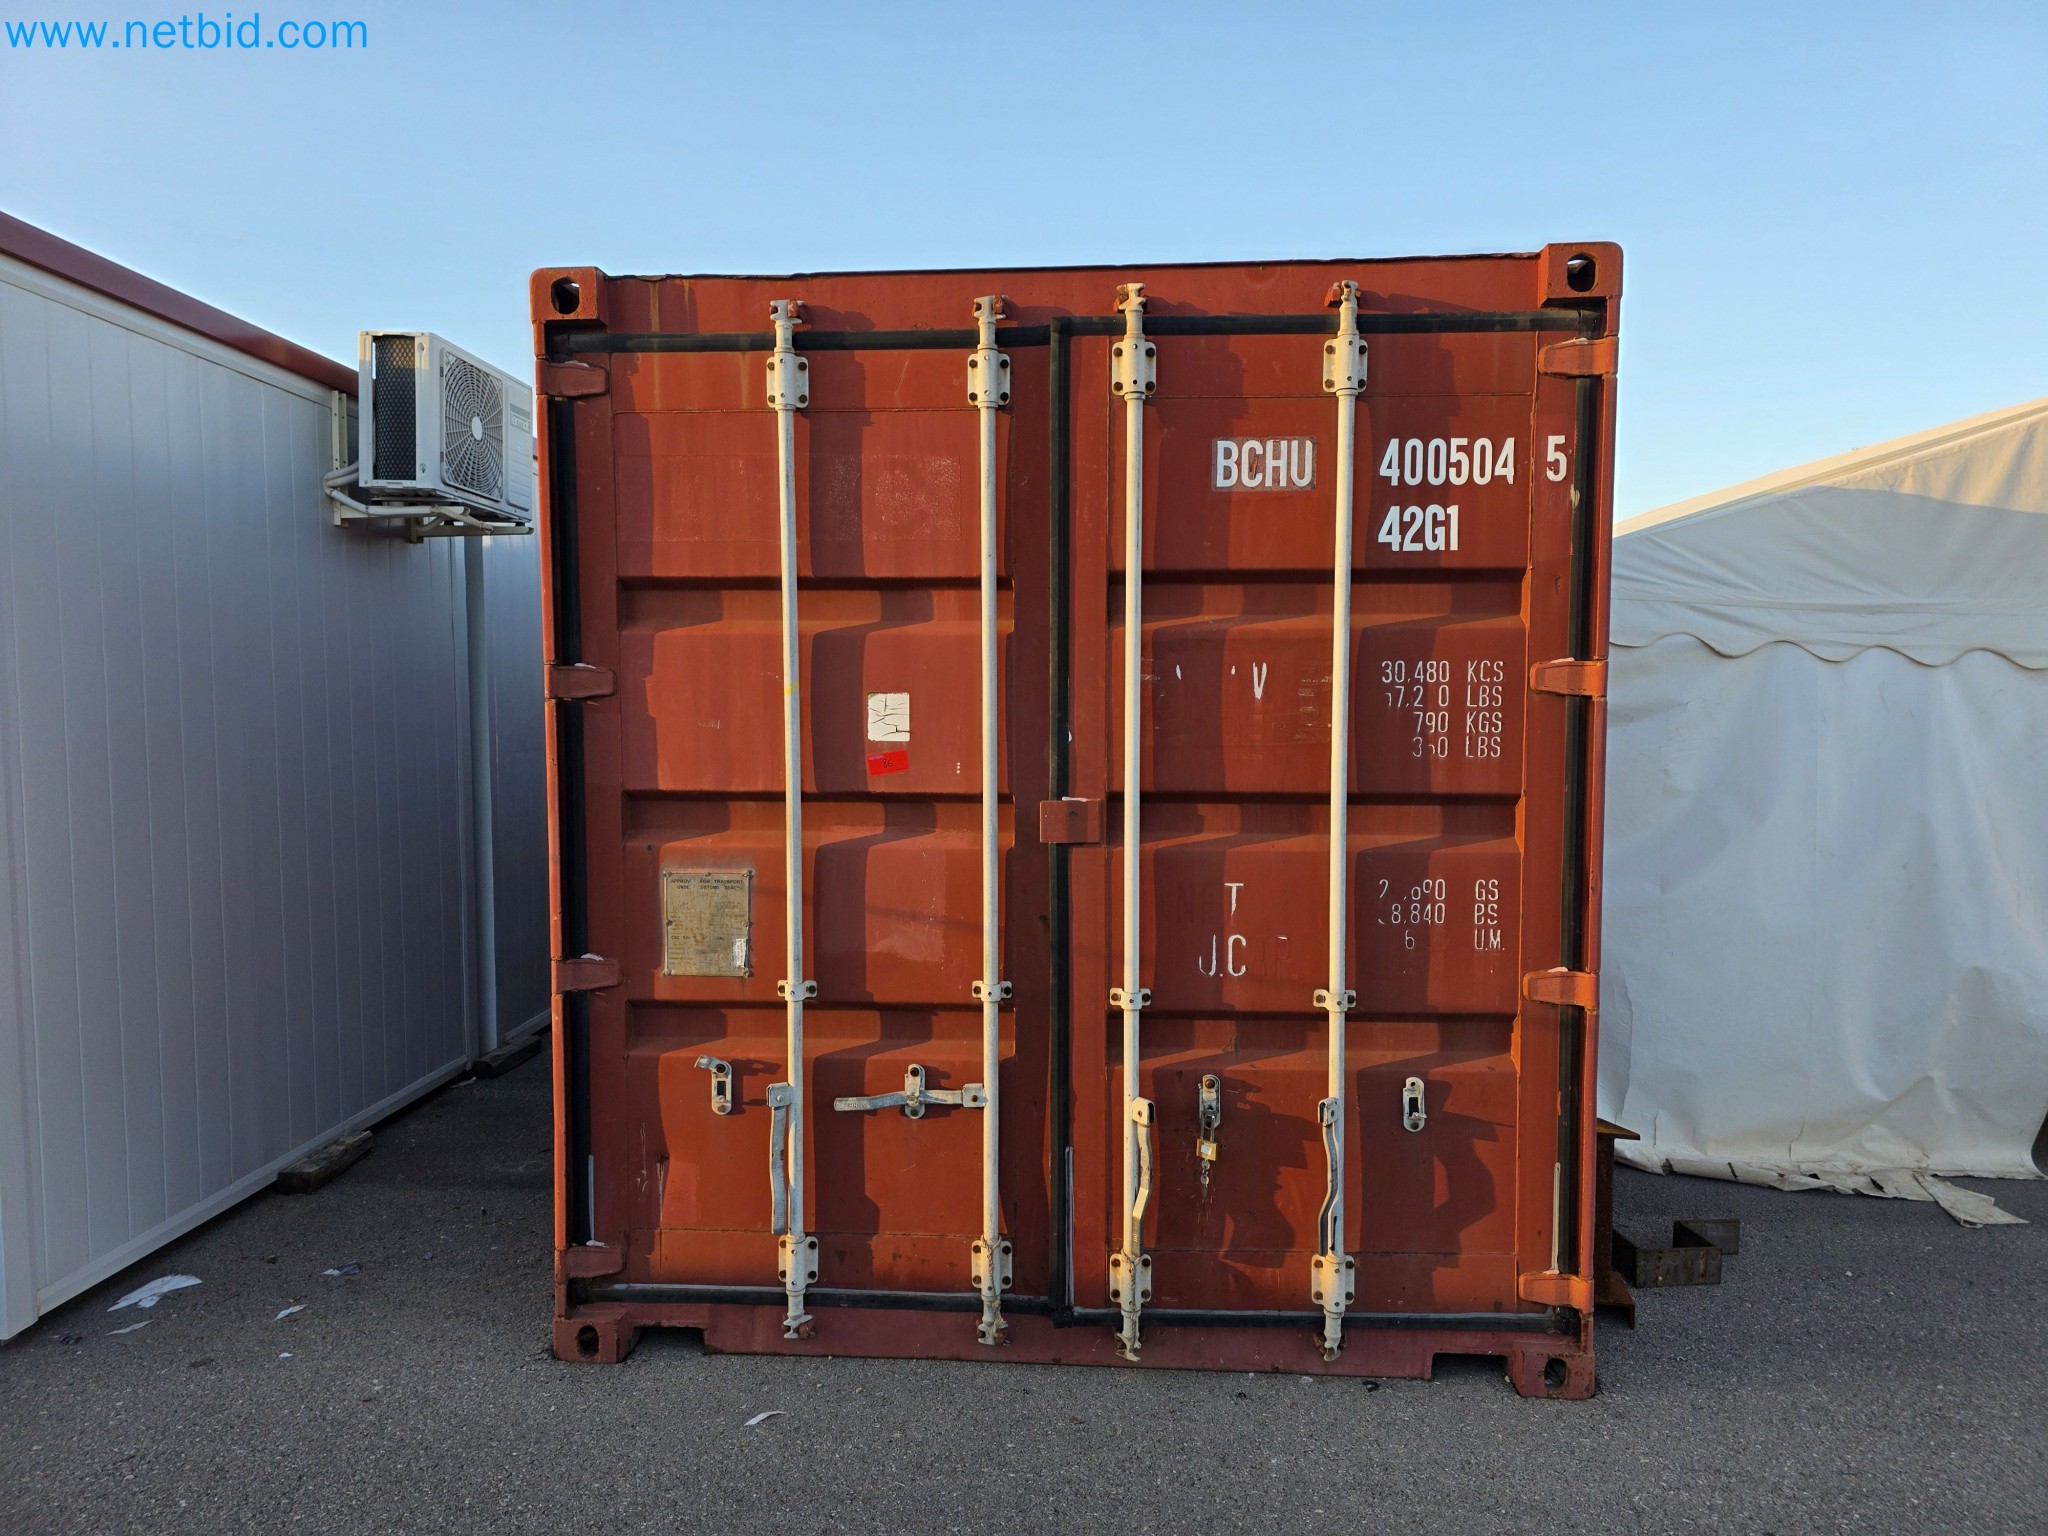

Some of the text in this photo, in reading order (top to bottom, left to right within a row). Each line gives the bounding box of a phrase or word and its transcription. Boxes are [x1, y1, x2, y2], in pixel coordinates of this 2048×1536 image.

[1216, 435, 1567, 487] BCHU 400504 5
[1378, 504, 1459, 551] 42G1
[1381, 660, 1449, 683] 30,480
[1466, 684, 1502, 707] LBS
[1466, 711, 1502, 733] KGS
[1465, 735, 1501, 757] LBS
